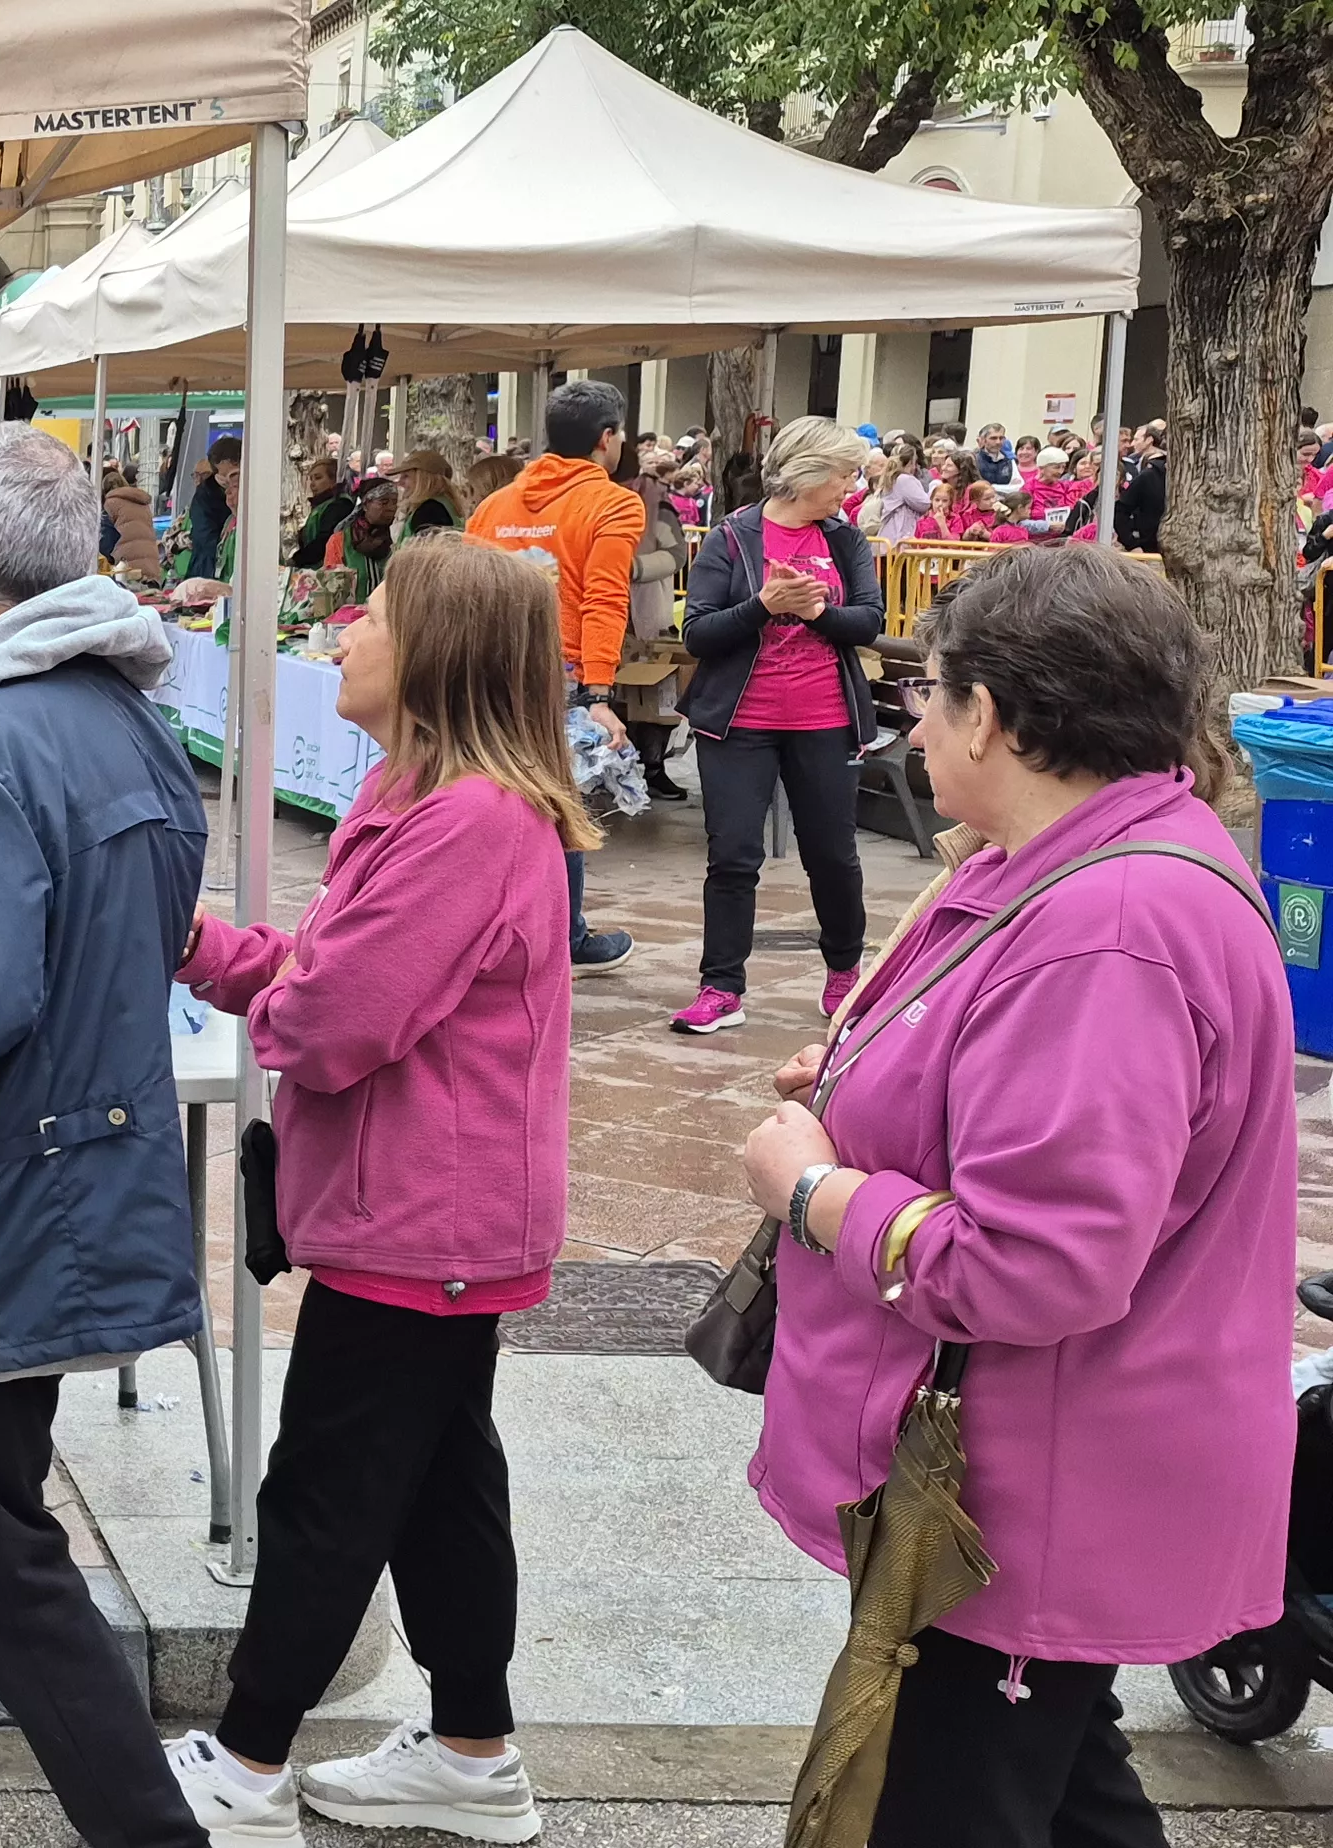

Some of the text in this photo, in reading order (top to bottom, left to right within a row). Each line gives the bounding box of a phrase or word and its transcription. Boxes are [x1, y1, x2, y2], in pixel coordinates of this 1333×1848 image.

[33, 101, 197, 133] MASTERTENT
[1014, 303, 1065, 312] MASTERTENT
[495, 524, 557, 539] Volunteer
